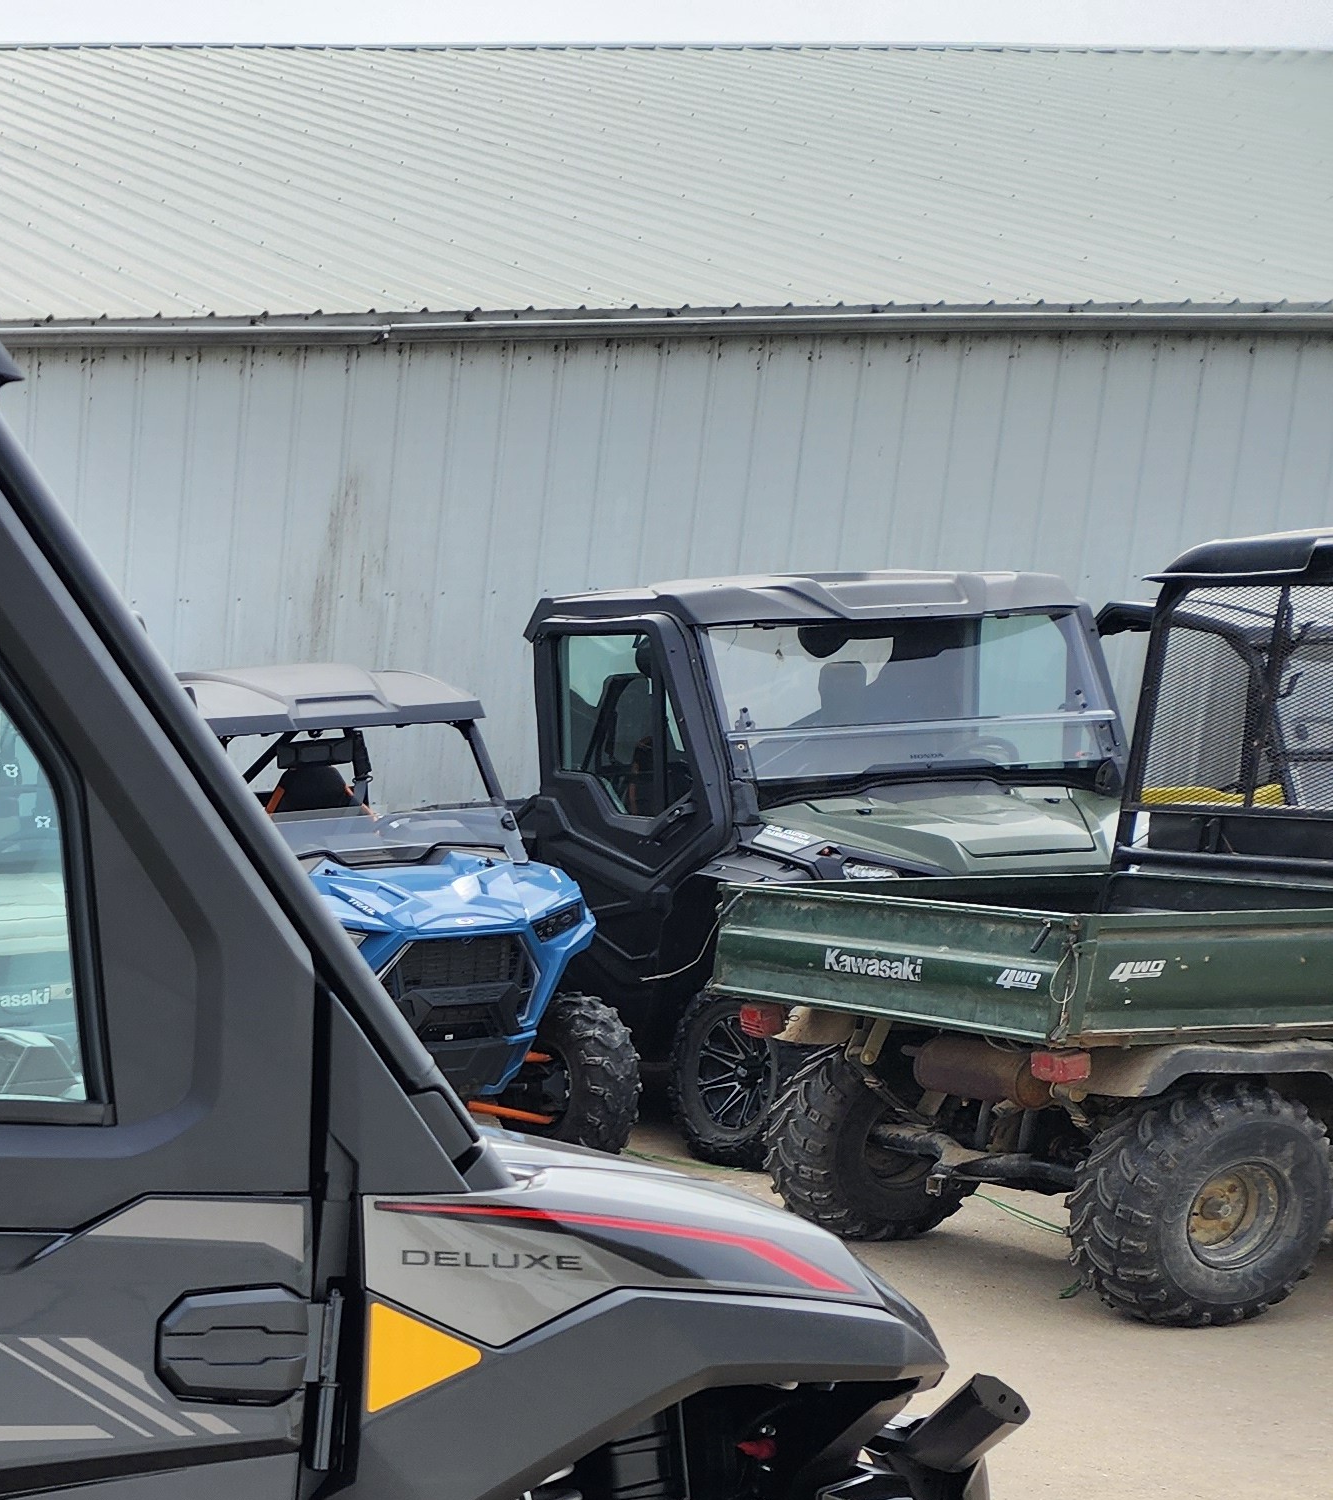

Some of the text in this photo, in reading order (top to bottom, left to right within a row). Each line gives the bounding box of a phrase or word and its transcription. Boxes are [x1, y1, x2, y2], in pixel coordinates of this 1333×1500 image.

[348, 897, 376, 916] TRAIL
[824, 947, 923, 982] Kawasaki
[1109, 960, 1167, 983] 4WD
[996, 968, 1042, 990] 4WD
[400, 1248, 583, 1272] DELUXE
